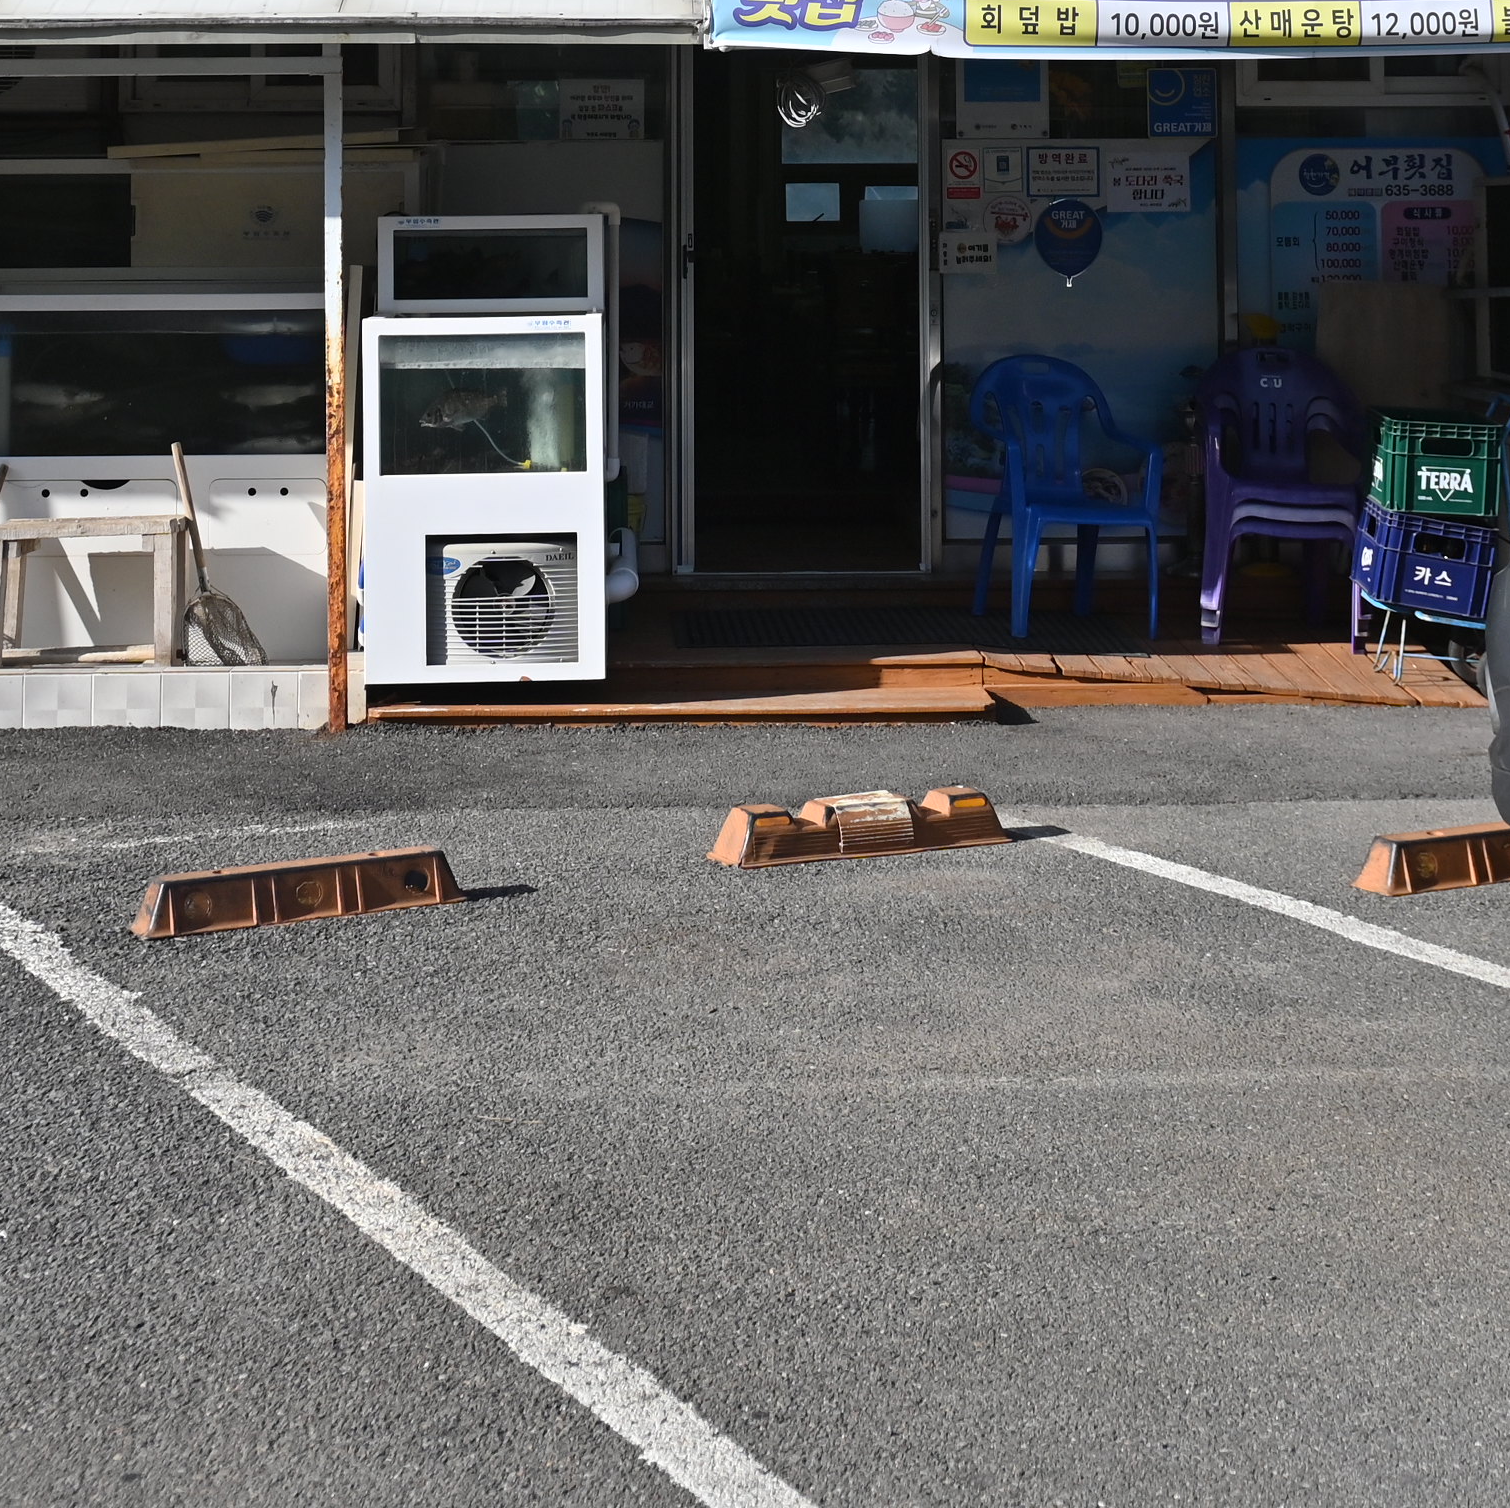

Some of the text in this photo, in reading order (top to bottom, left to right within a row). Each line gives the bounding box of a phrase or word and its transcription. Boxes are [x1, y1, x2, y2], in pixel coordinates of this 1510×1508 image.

[981, 5, 1220, 40] 회덮밥 10,000원
[1239, 8, 1479, 40] 산매운탕 12,000원
[1038, 152, 1088, 165] 방역완료
[1350, 153, 1453, 180] 어부횟집
[1385, 184, 1454, 196] 635-3688
[1051, 210, 1085, 220] GREAT
[1325, 210, 1360, 221] 50,000
[1325, 226, 1360, 237] 70,000
[1447, 225, 1475, 236] 10,00
[1452, 237, 1475, 247] 8,00
[1417, 469, 1473, 493] TERRA
[545, 553, 574, 562] DAEIL
[1413, 565, 1452, 587] 카스
